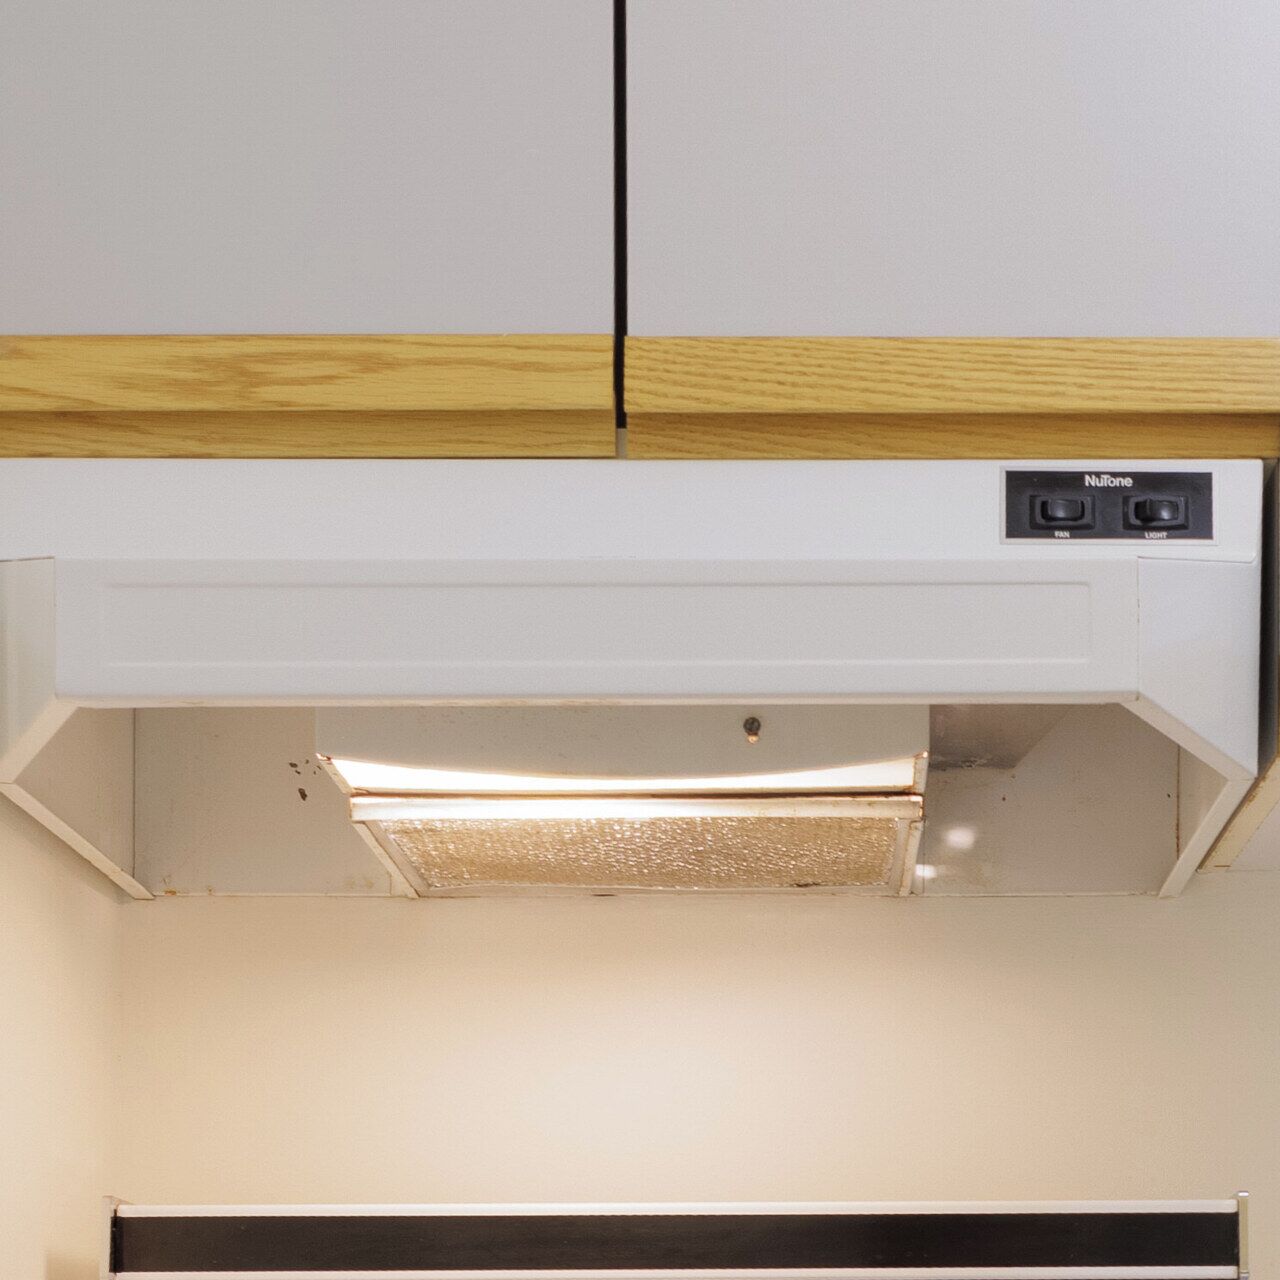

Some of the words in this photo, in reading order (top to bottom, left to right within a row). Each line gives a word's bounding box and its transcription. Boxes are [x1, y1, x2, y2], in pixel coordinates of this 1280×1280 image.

[1084, 474, 1134, 488] NuTone
[1054, 530, 1071, 539] FAN
[1144, 531, 1169, 540] LIGHT
